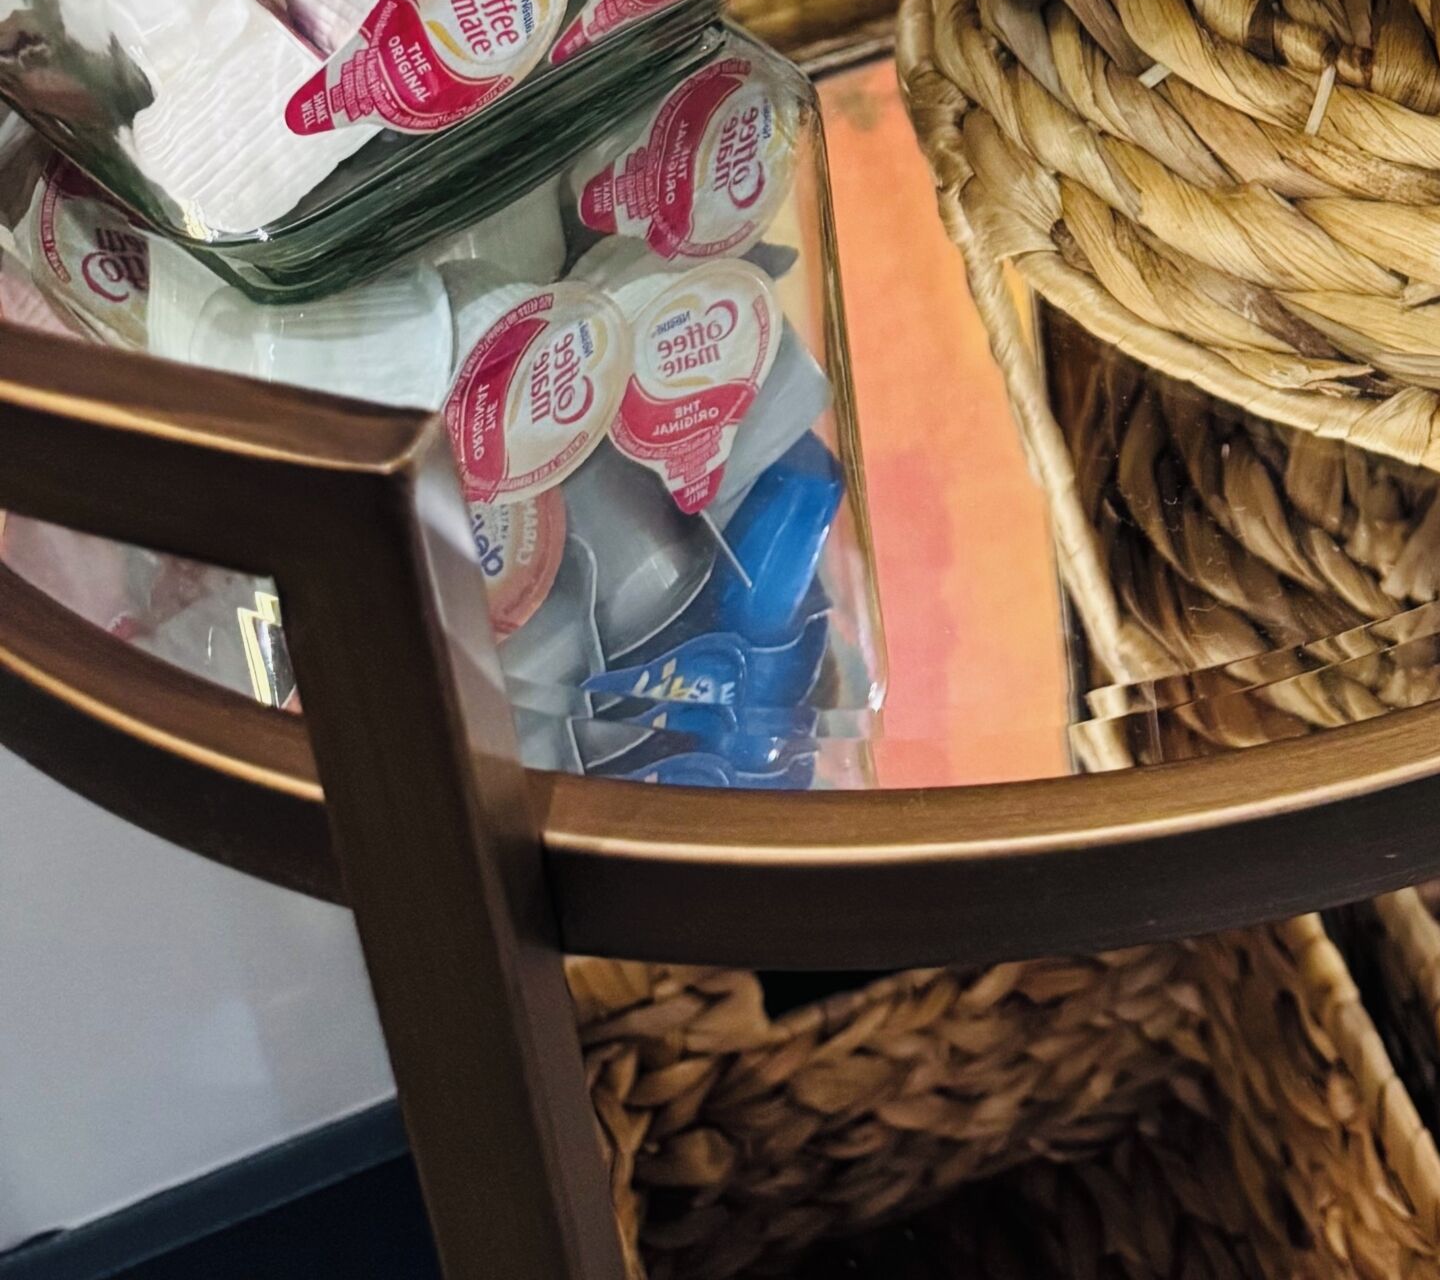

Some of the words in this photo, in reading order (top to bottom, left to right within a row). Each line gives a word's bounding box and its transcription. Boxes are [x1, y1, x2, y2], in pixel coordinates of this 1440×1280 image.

[387, 34, 431, 104] ORIGINAL
[406, 41, 432, 76] THE
[300, 98, 317, 130] WELL
[313, 90, 329, 124] SHAKE
